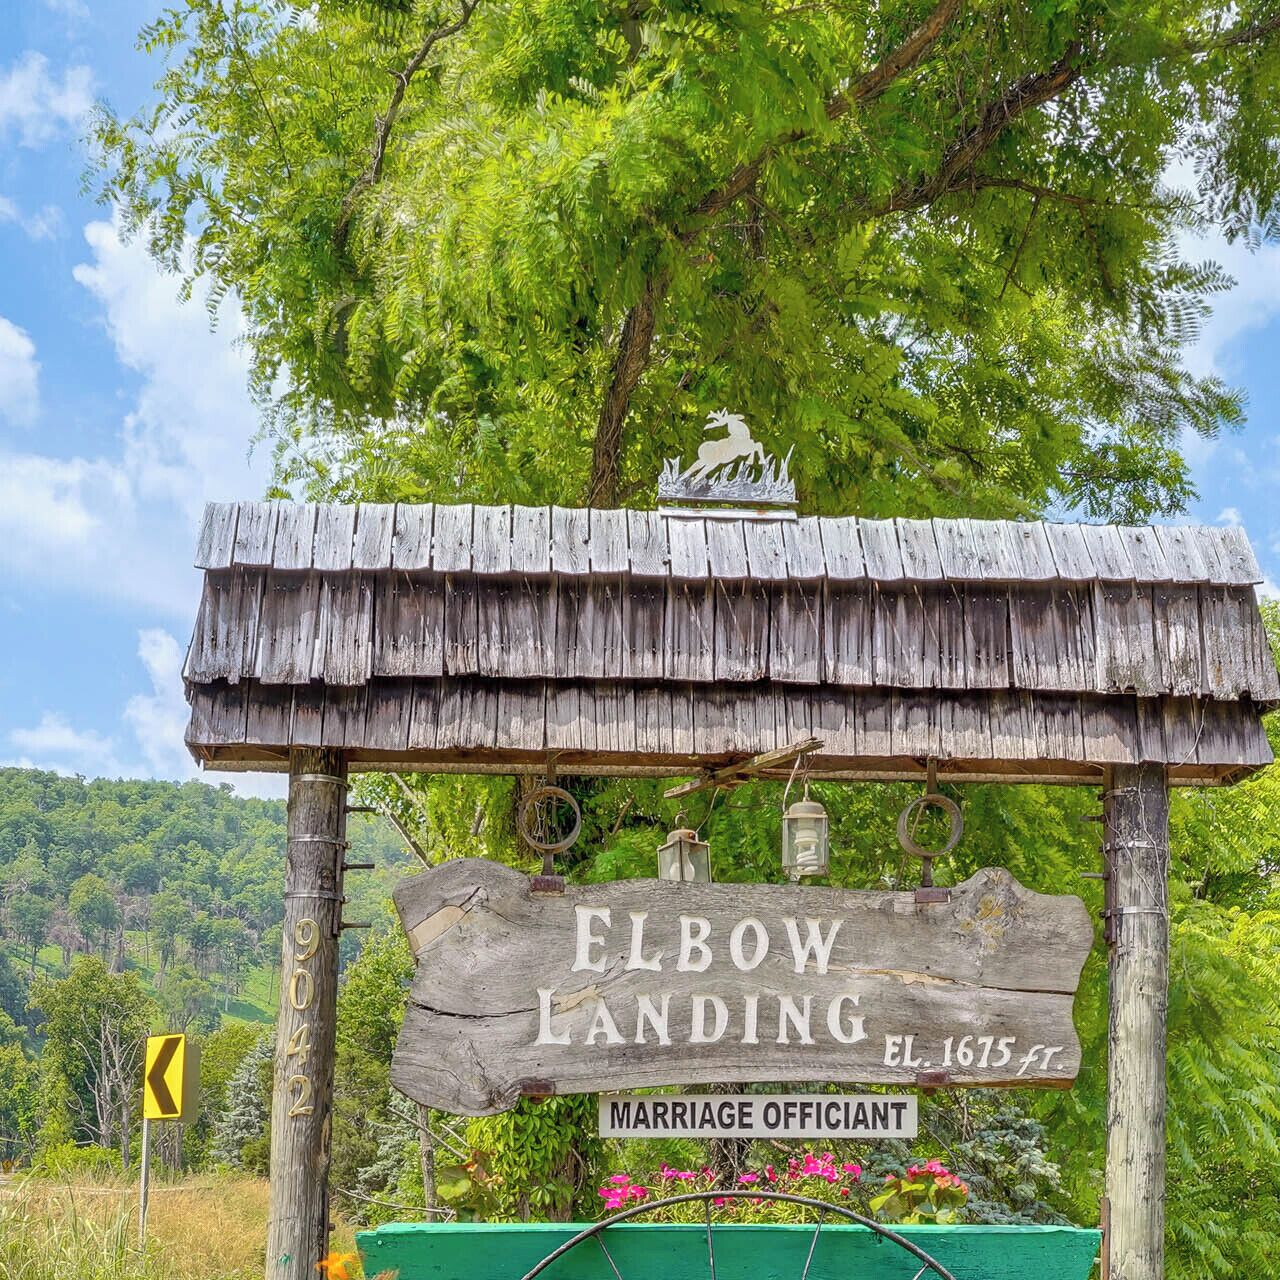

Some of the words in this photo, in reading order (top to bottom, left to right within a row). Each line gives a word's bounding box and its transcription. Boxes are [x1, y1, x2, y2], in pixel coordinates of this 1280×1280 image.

[571, 904, 845, 974] ELBOW
[287, 918, 320, 1117] 9042
[533, 987, 868, 1045] LANDING
[883, 1034, 930, 1067] EL.
[942, 1035, 1016, 1068] 1675
[610, 1101, 753, 1130] MARRIAGE
[762, 1101, 907, 1130] OFFICIANT
